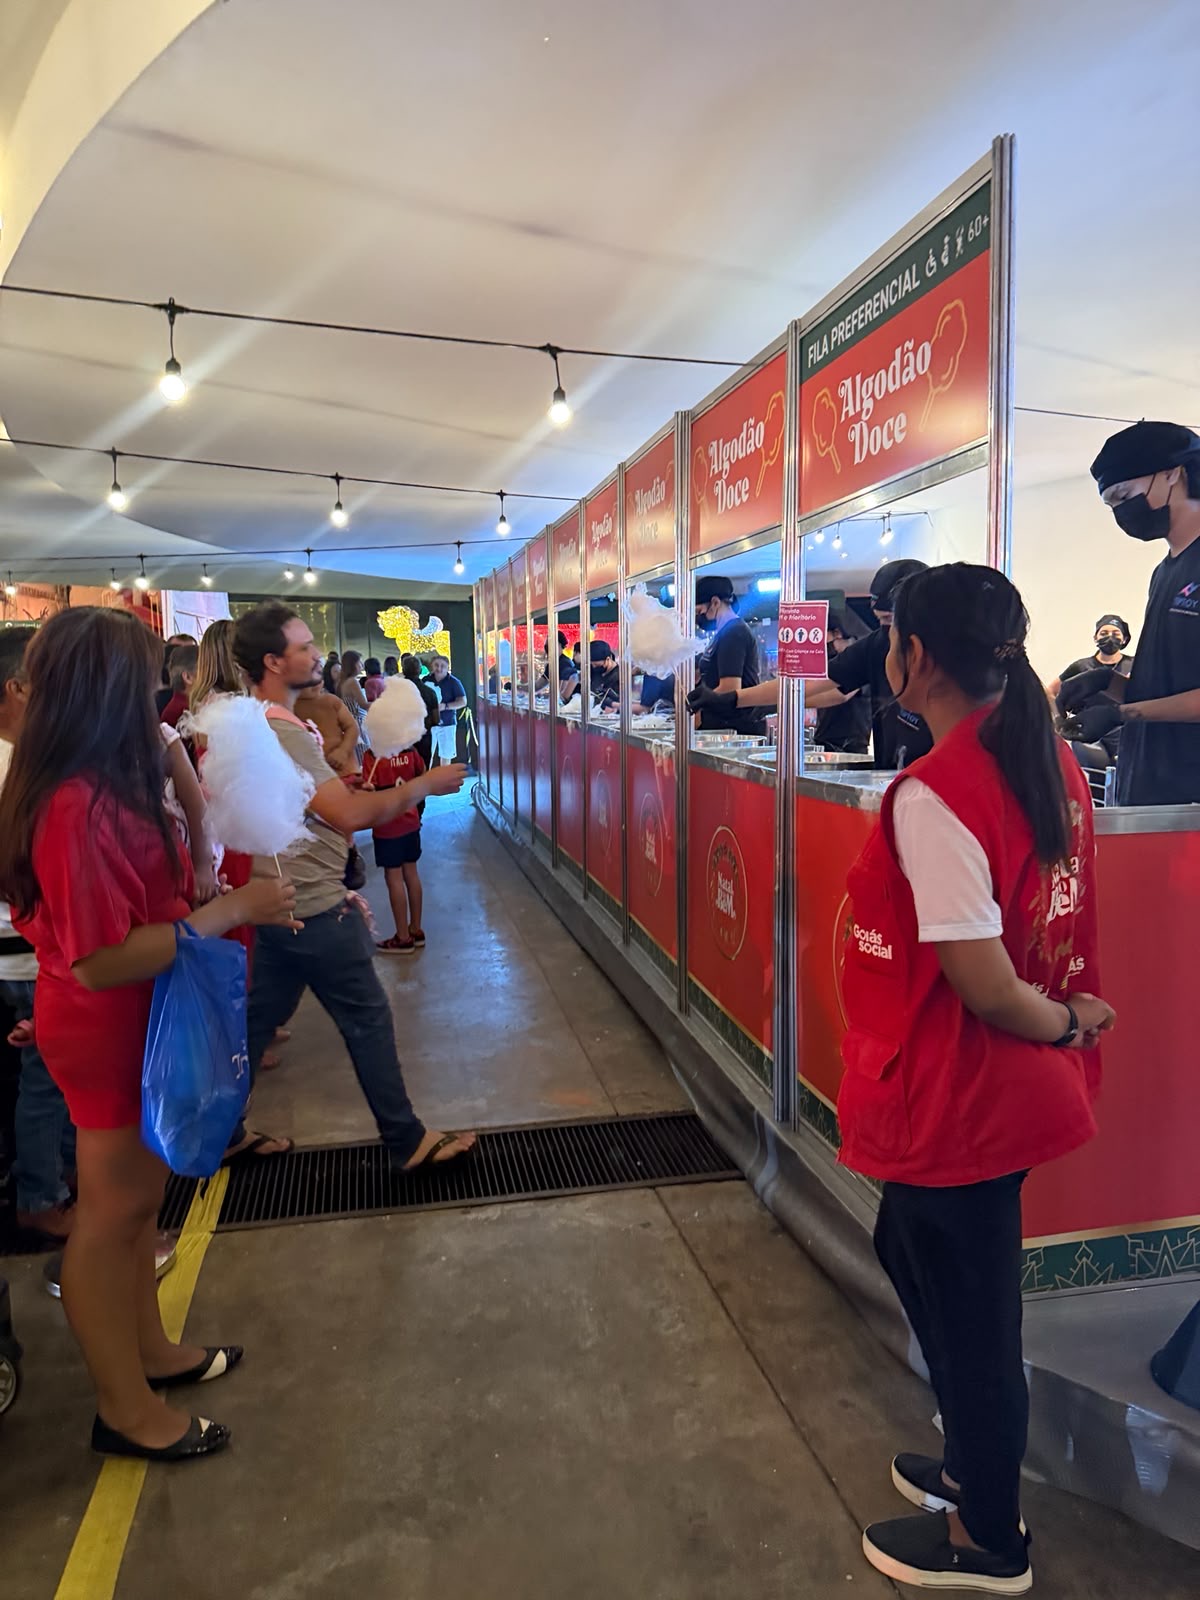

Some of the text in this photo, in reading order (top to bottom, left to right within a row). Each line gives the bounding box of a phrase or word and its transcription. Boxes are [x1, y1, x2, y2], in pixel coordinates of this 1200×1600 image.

[808, 214, 990, 369] FILA PREFERENCIAL 60+
[838, 338, 931, 423] Algodão
[708, 416, 764, 479] Algodão
[848, 412, 907, 465] Doce
[714, 477, 749, 514] Doce
[390, 756, 409, 767] ITALO
[853, 923, 883, 945] Goiás
[858, 940, 893, 960] social
